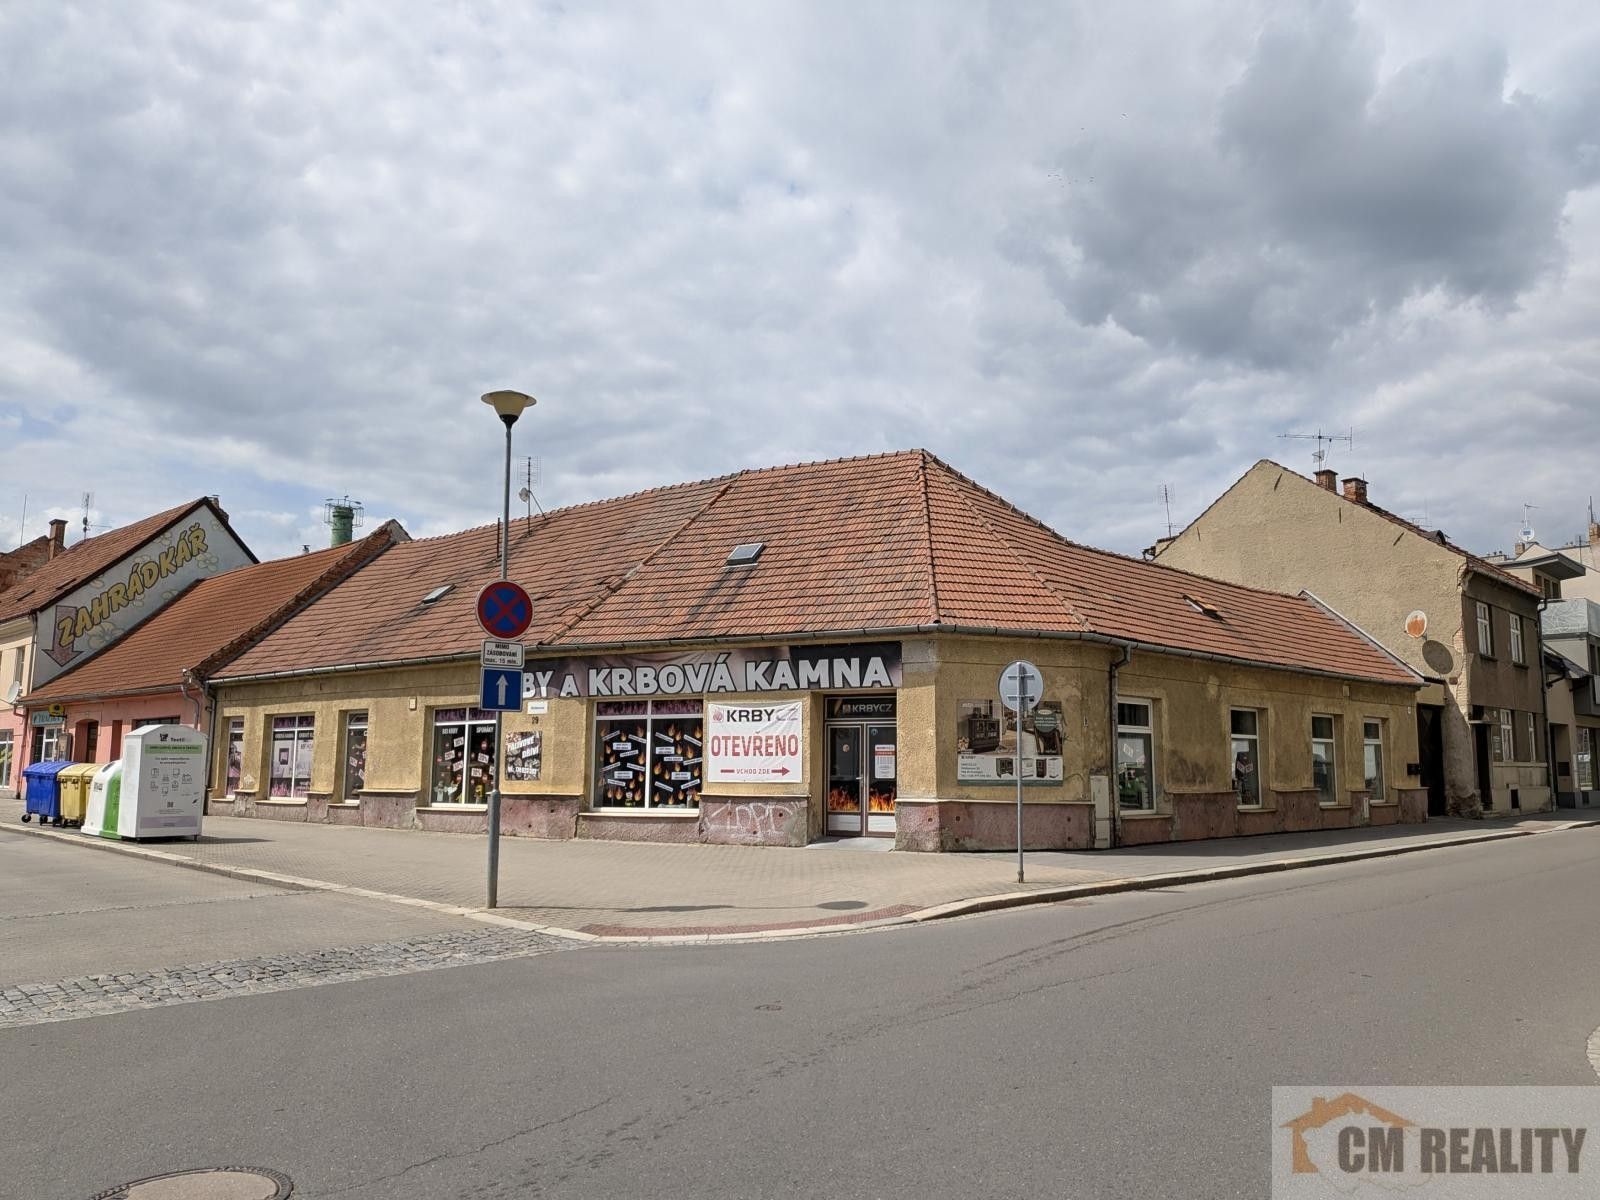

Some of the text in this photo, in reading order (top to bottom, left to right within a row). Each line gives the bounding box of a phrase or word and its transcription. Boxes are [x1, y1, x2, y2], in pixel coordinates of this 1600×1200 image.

[57, 522, 209, 647] ZAHRÁDKÁŘ
[522, 652, 893, 698] BY A KRBOVÁ KAMNA
[711, 731, 799, 757] OTEVŘENO
